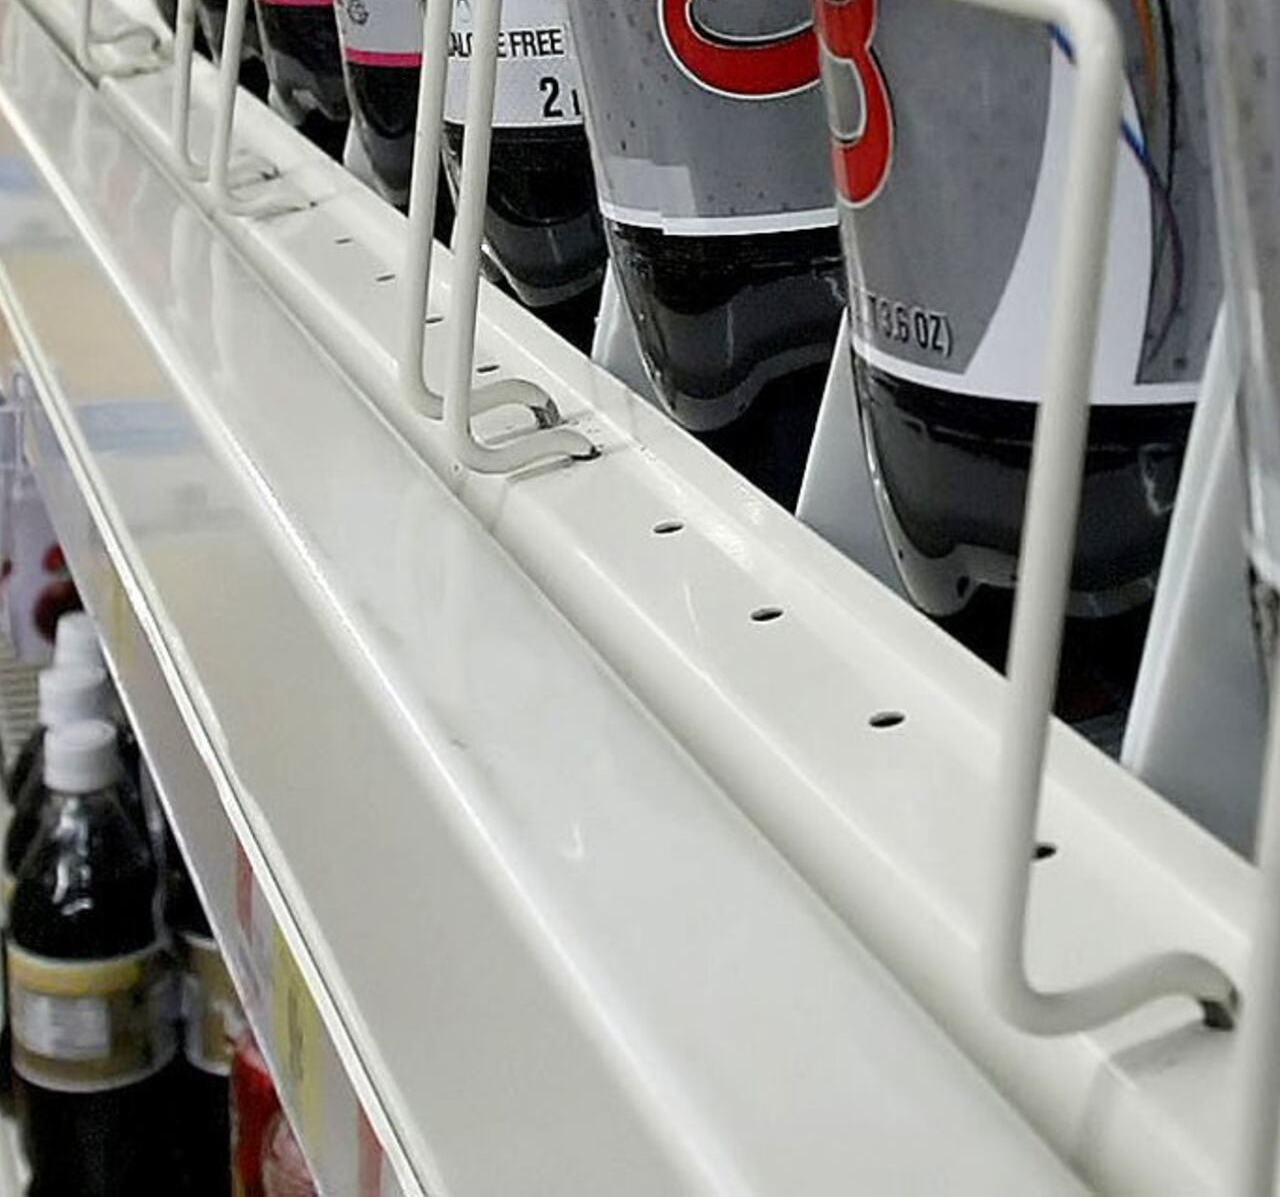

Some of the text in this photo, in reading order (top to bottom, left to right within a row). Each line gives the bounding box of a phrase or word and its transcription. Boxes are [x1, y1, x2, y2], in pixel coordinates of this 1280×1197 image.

[509, 28, 565, 57] FREE
[539, 76, 563, 118] 2
[914, 310, 953, 358] OZ)
